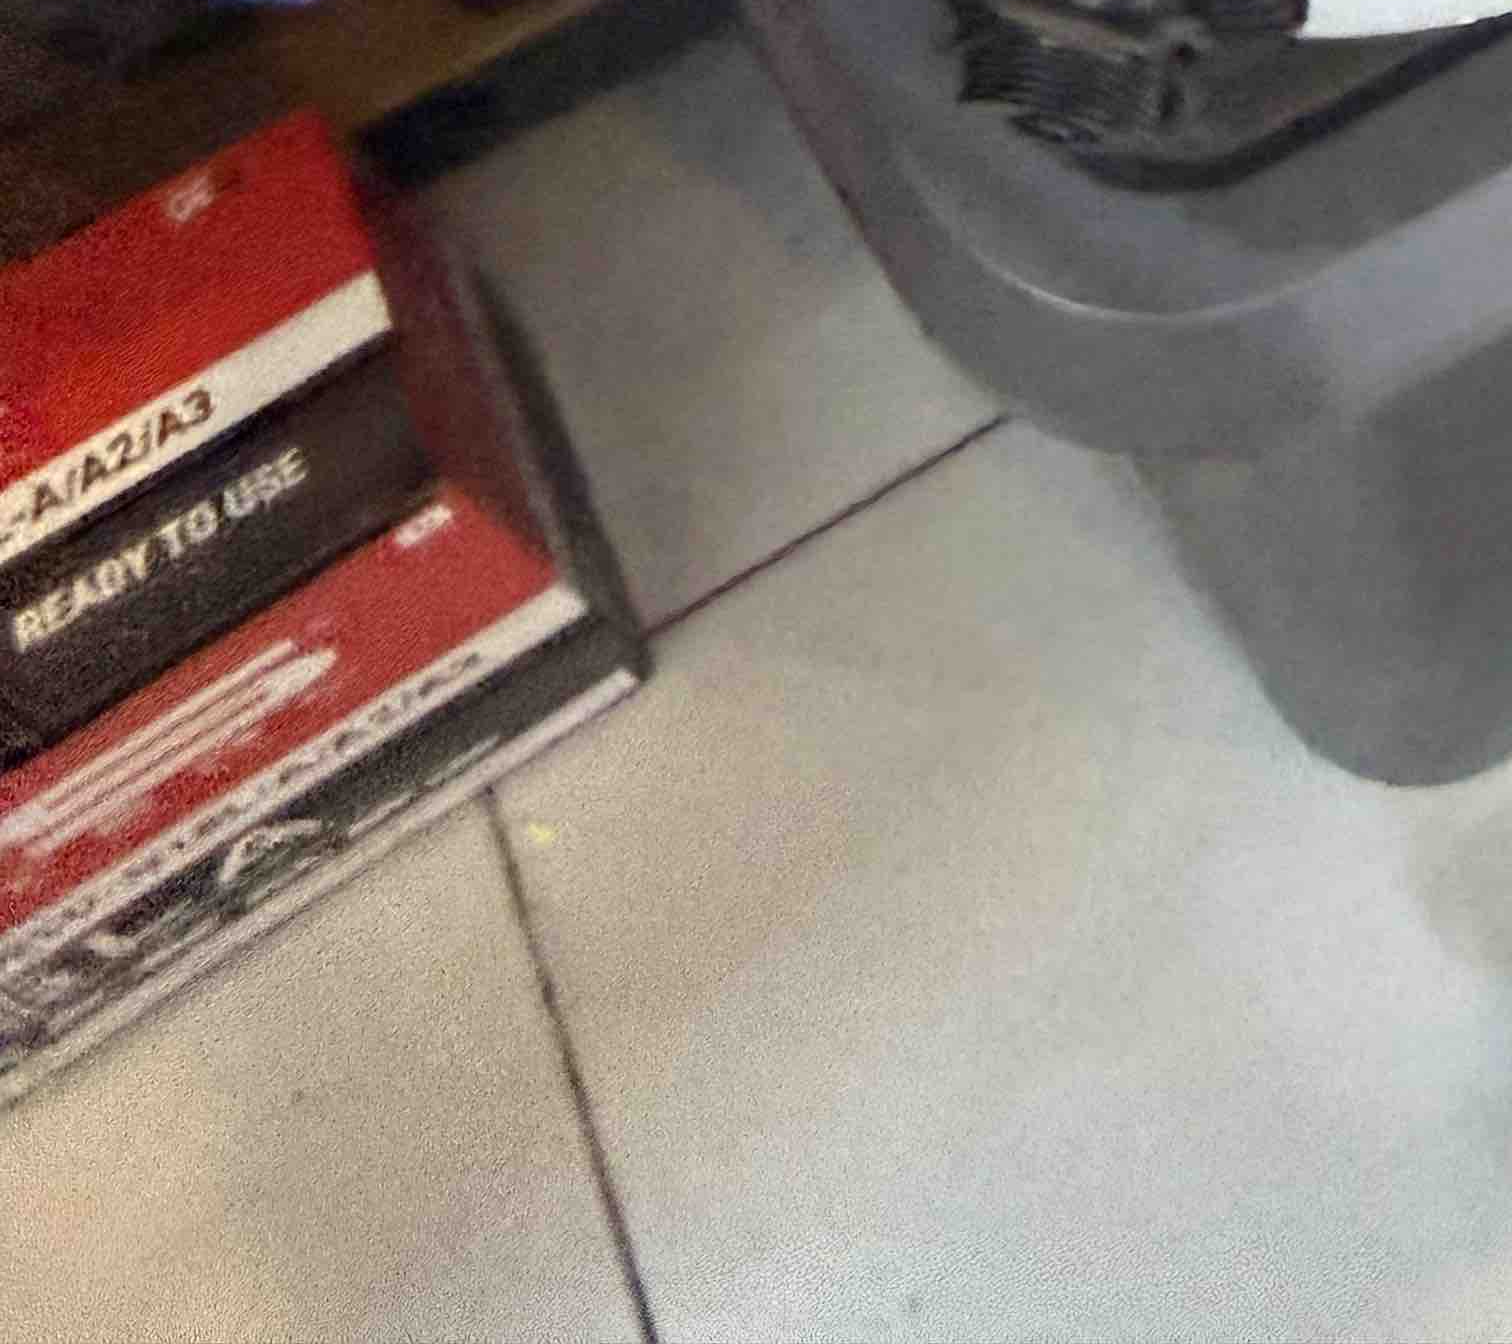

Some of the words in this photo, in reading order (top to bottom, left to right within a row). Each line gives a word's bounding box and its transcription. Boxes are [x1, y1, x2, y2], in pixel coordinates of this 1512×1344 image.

[13, 542, 156, 654] READY
[155, 500, 220, 560] TO
[222, 446, 308, 519] USE
